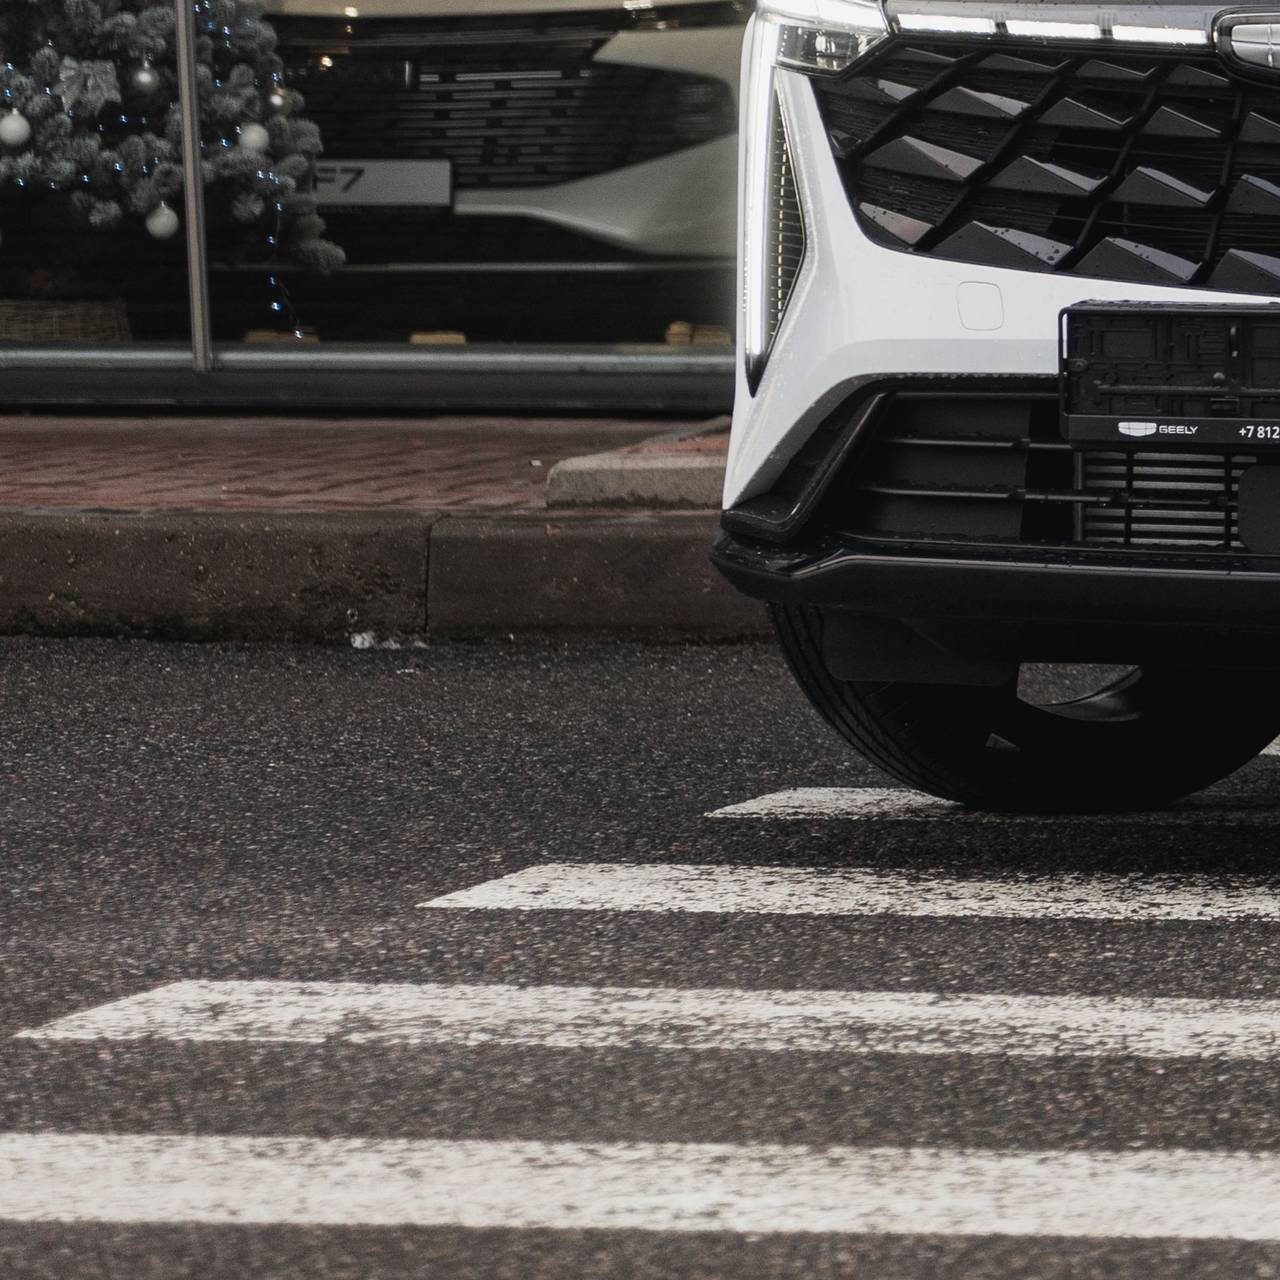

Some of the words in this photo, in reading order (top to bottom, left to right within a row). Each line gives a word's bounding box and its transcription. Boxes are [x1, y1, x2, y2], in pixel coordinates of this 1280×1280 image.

[1158, 425, 1199, 435] GEELY
[1238, 425, 1255, 439] +7
[1256, 426, 1280, 439] 812
